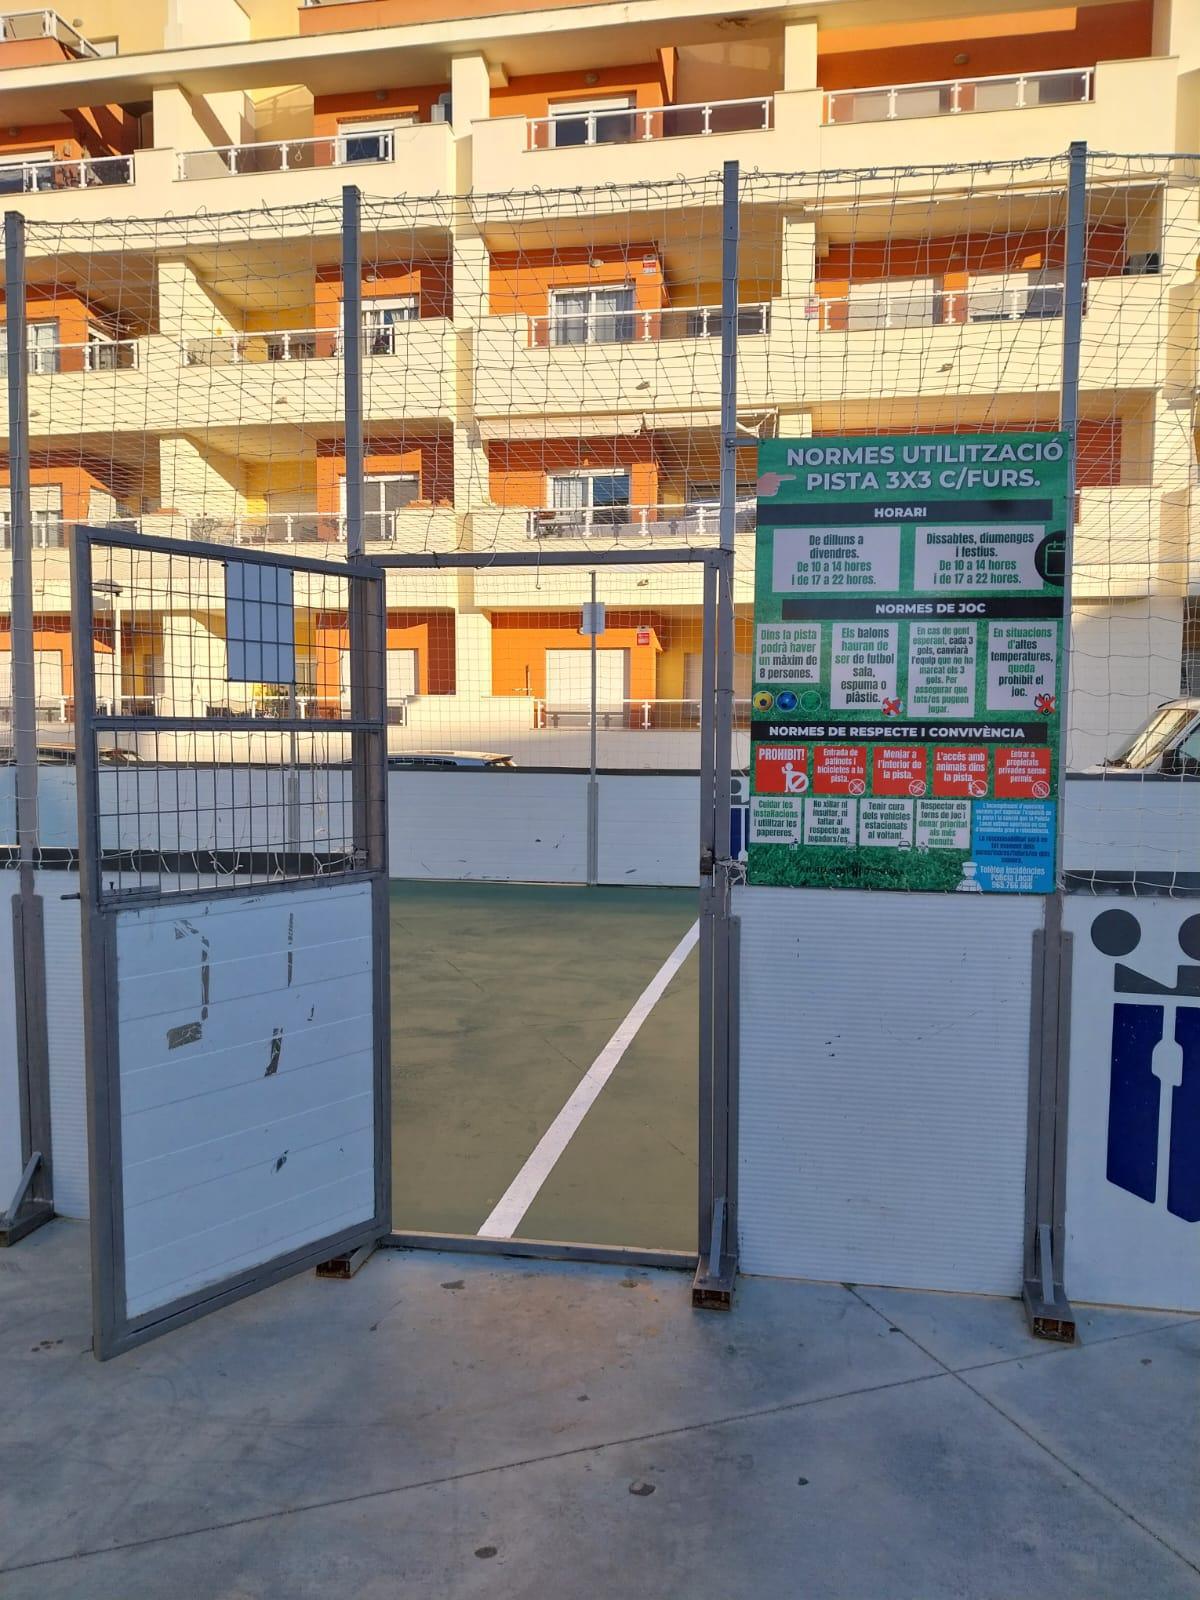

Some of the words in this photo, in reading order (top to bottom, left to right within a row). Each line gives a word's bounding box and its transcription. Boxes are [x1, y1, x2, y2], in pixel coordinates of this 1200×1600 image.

[787, 447, 894, 466] NORMES
[904, 438, 1063, 464] UTILITZACIÓ
[807, 472, 878, 490] PISTA
[886, 470, 932, 489] 3X3
[940, 467, 1040, 490] C/FURS.
[874, 507, 926, 518] HORARI
[809, 535, 820, 545] De
[824, 534, 855, 545] dilluns
[858, 536, 864, 544] a
[927, 533, 976, 545] Dissabtes,
[980, 532, 1034, 544] diumenges
[810, 548, 859, 558] divendres.
[956, 547, 958, 557] i
[962, 546, 998, 557] festius.
[797, 562, 808, 572] De
[812, 562, 821, 572] 10
[824, 563, 829, 572] a
[832, 562, 841, 571] 14
[845, 561, 872, 571] hores
[940, 560, 951, 570] De
[954, 560, 964, 570] 10
[967, 561, 972, 570] a
[976, 560, 985, 570] 14
[989, 560, 1016, 570] hores
[792, 575, 794, 585] i
[798, 575, 808, 585] de
[812, 575, 821, 585] 17
[824, 576, 829, 585] a
[832, 575, 843, 585] 22
[846, 574, 876, 584] hores.
[934, 574, 936, 584] i
[940, 574, 951, 584] de
[955, 574, 964, 583] 17
[967, 575, 972, 583] a
[976, 574, 987, 583] 22
[991, 573, 1021, 583] hores.
[876, 604, 932, 613] NORMES
[937, 604, 955, 613] DE
[958, 604, 986, 613] JOC
[761, 630, 780, 639] Dins
[783, 630, 791, 640] la
[794, 629, 816, 641] pista
[842, 628, 854, 638] Els
[858, 628, 889, 638] balons
[942, 627, 952, 635] de
[953, 627, 969, 636] gent
[994, 628, 1003, 637] En
[1006, 628, 1052, 637] situacions
[790, 643, 816, 652] haver
[842, 641, 874, 651] hauran
[877, 641, 888, 650] de
[1008, 640, 1037, 649] d'altes
[759, 657, 770, 665] un
[806, 655, 817, 665] de
[835, 655, 850, 664] ser
[853, 654, 864, 664] de
[867, 653, 894, 664] futbol
[991, 652, 1053, 662] temperatures,
[1008, 663, 1035, 673] queda
[760, 668, 765, 678] 8
[768, 668, 813, 680] persones.
[999, 676, 1032, 686] prohibit
[1036, 675, 1043, 684] el
[841, 681, 878, 691] espuma
[881, 681, 886, 689] o
[1012, 687, 1027, 697] joc.
[770, 727, 824, 736] NORMES
[828, 727, 846, 736] DE
[850, 727, 917, 736] RESPECTE
[922, 728, 924, 736] I
[929, 726, 1025, 738] CONVIVÈNCIA
[760, 749, 804, 760] PROHIBIT!
[968, 752, 985, 761] amb
[878, 760, 909, 768] l'interior
[884, 770, 890, 778] la
[893, 770, 913, 780] pista.
[944, 773, 951, 781] la
[865, 821, 907, 830] estacionats
[877, 831, 904, 839] voltant.
